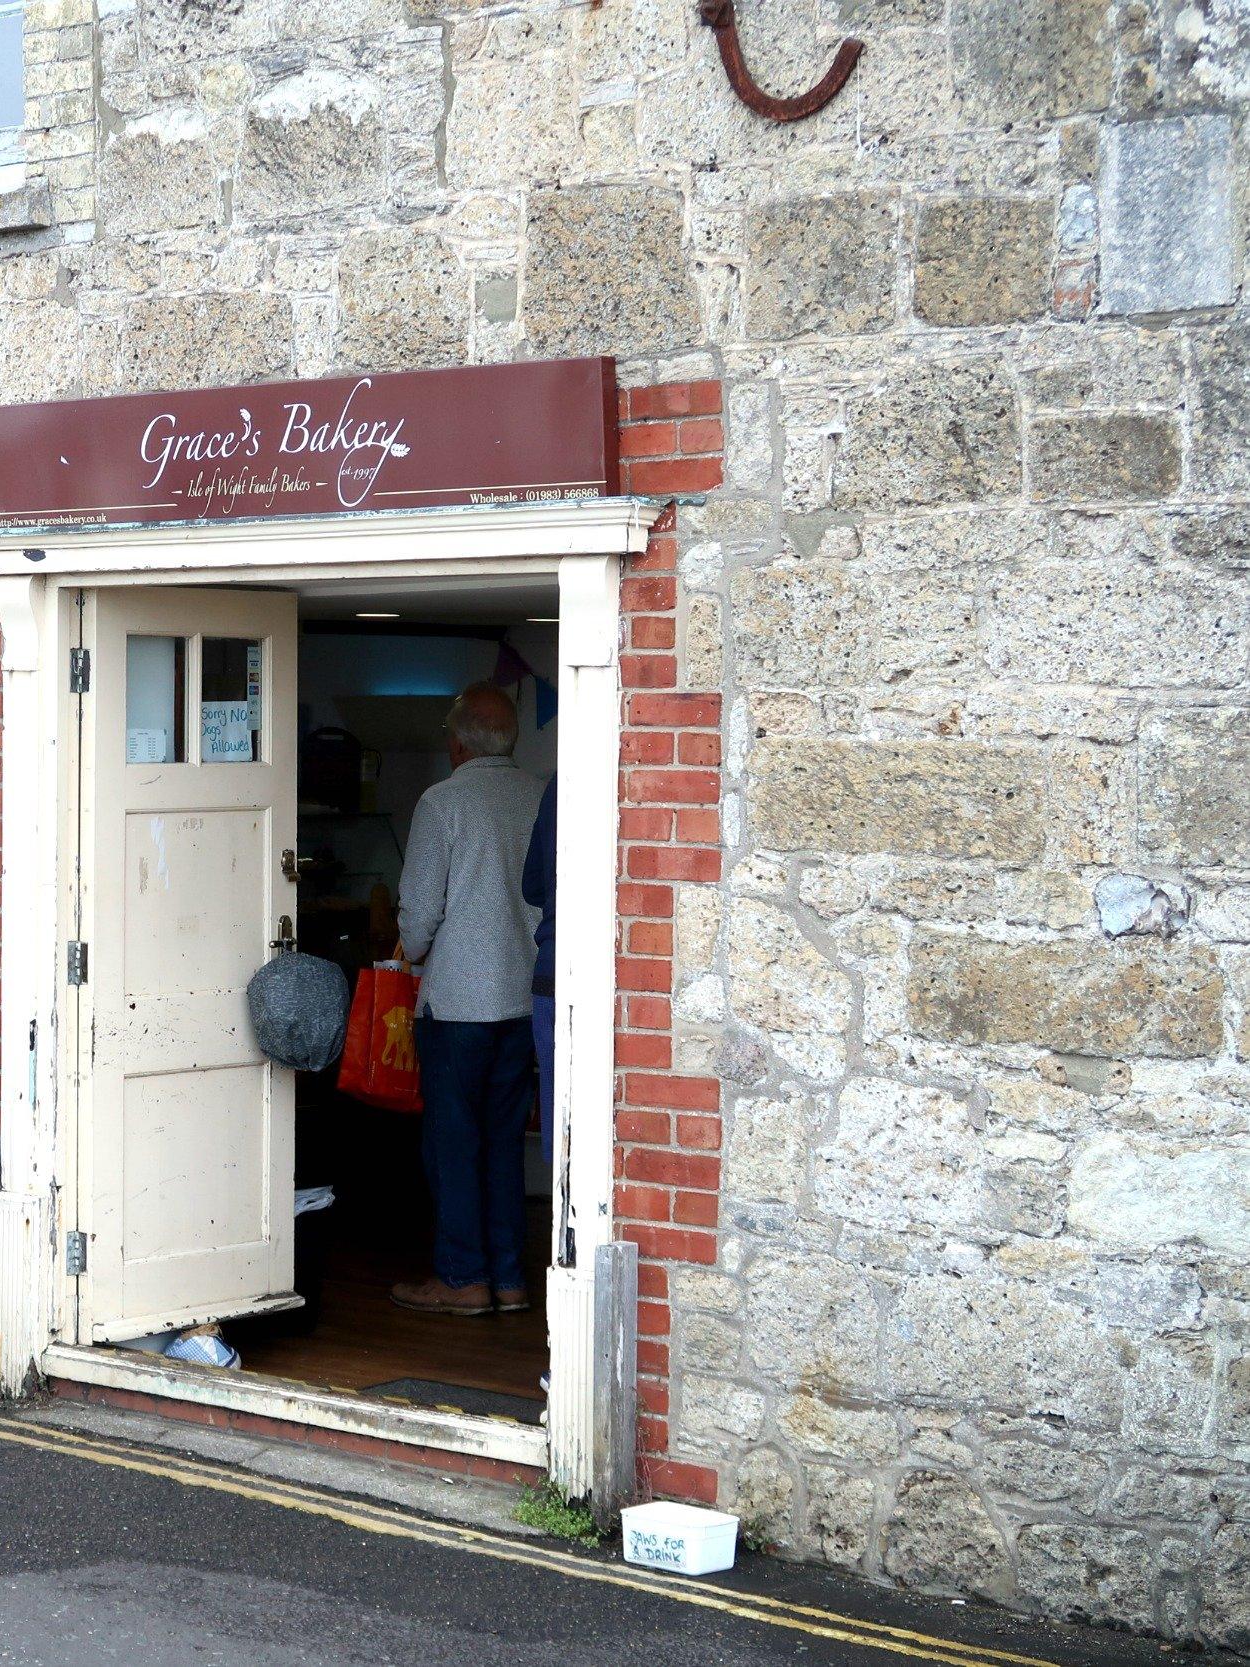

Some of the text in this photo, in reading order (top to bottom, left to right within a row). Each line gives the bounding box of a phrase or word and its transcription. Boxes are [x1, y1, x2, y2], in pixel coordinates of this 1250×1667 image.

[140, 378, 408, 507] Grace's Bakery
[187, 466, 311, 518] Isle of Wight Family Bakers
[470, 492, 518, 503] Wholesale
[525, 488, 561, 502] (01983)
[564, 488, 599, 499] 566868
[201, 707, 227, 726] Sorry
